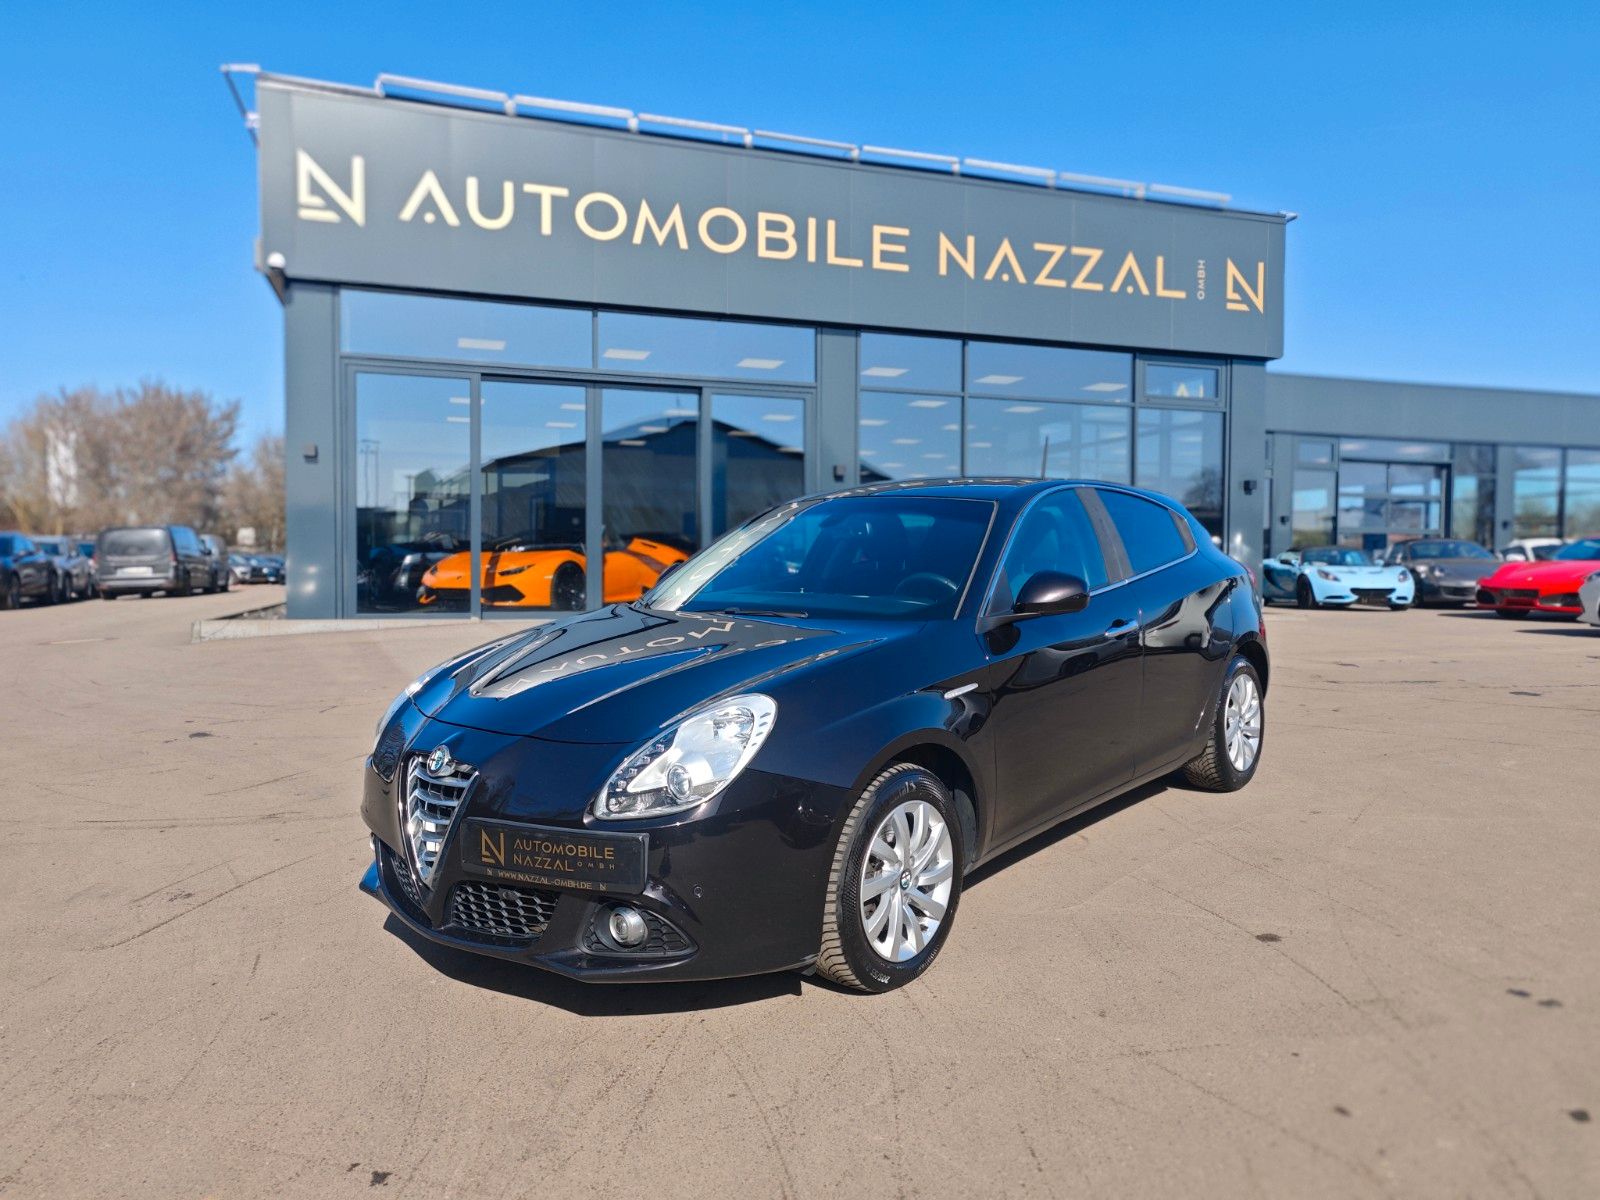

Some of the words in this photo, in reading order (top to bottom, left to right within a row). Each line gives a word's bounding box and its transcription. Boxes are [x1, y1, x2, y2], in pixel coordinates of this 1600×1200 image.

[399, 170, 911, 274] AUTOMOBILE
[937, 231, 1187, 301] NAZZAL
[513, 838, 615, 860] AUTOMOBILE
[513, 853, 575, 872] NAZZAL
